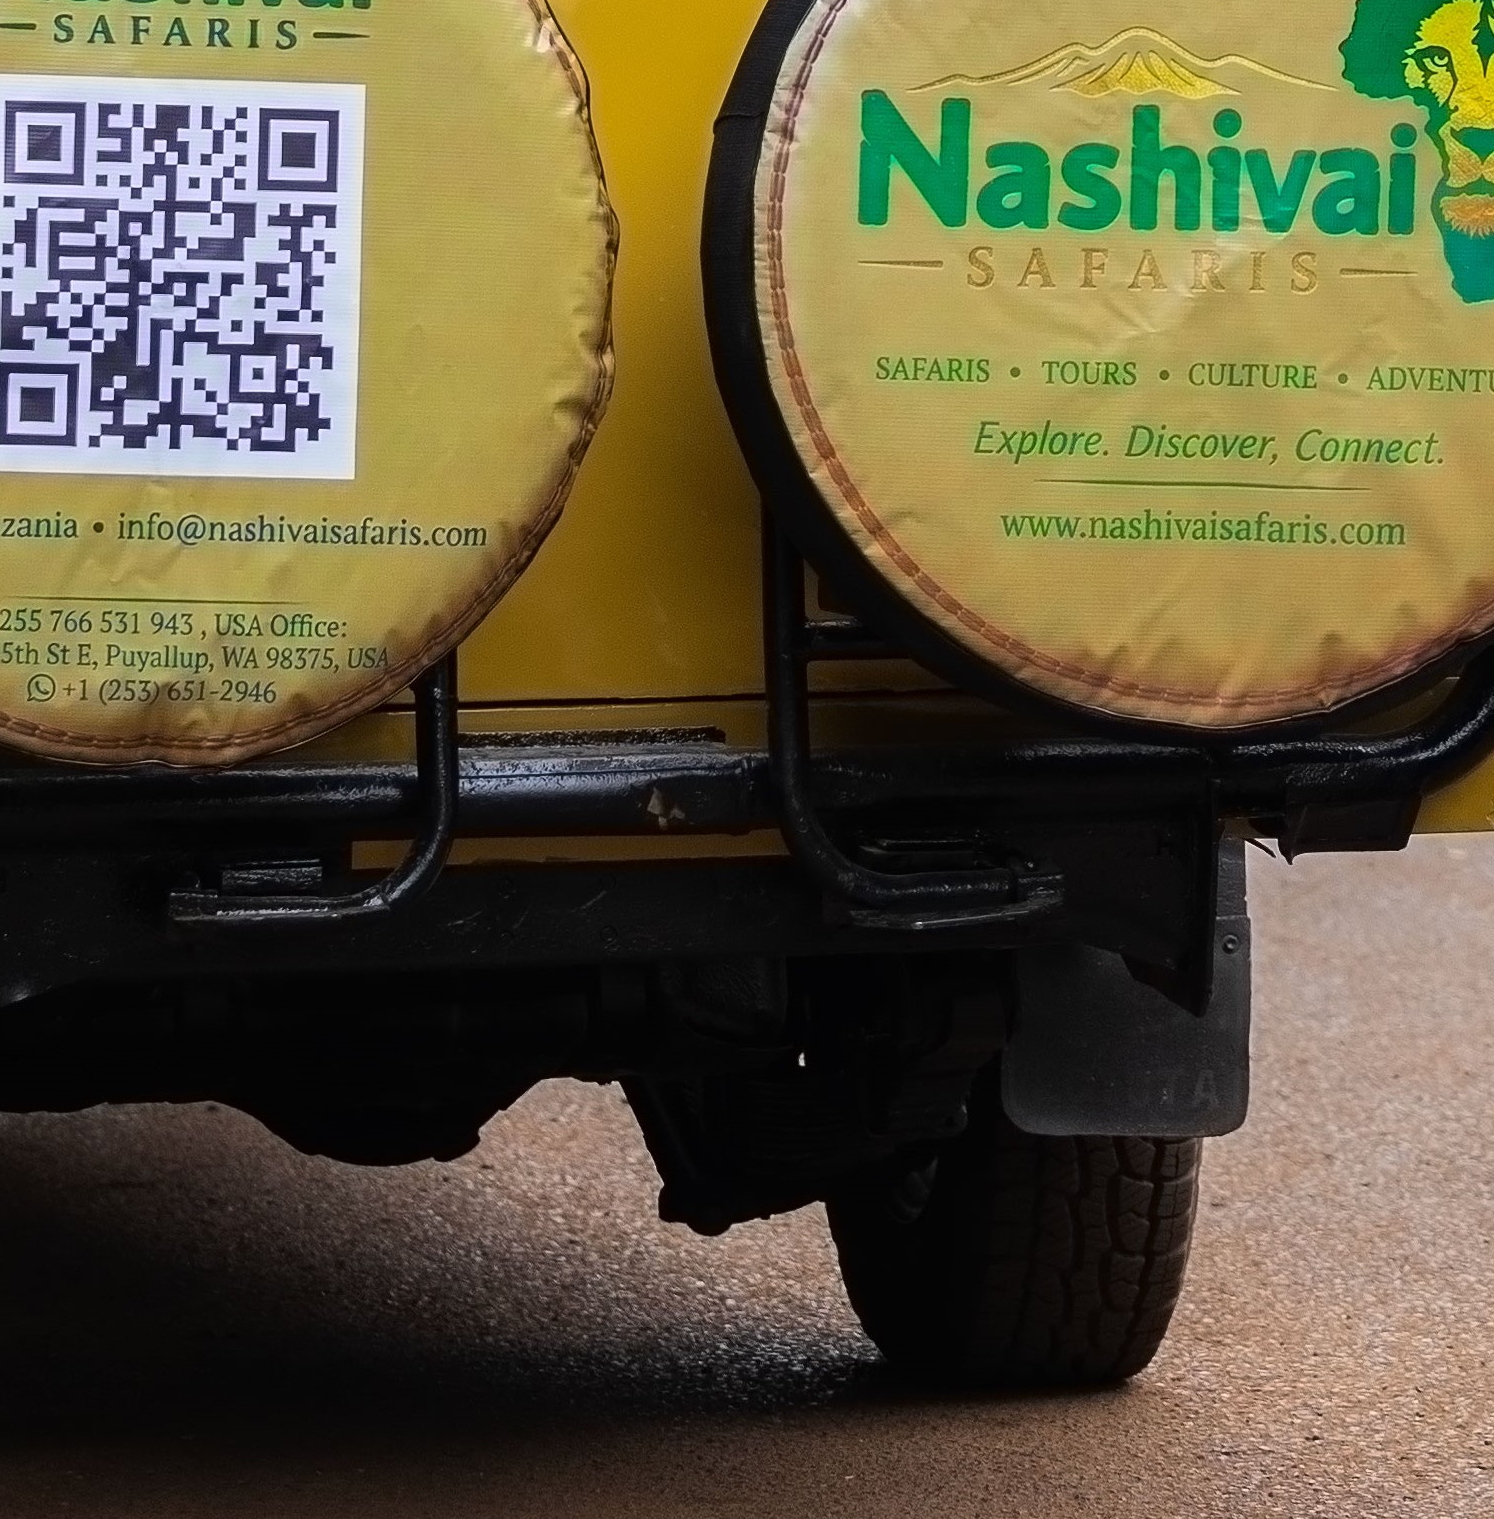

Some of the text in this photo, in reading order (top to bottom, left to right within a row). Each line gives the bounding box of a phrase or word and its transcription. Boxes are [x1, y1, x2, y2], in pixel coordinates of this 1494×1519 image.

[51, 12, 301, 49] SAFARIS
[856, 89, 1416, 236] Nashivai
[967, 246, 1320, 293] SAFARIS
[874, 357, 990, 383] SAFARIS
[1042, 361, 1137, 386] TOURS
[1188, 363, 1318, 389] CULTURE
[973, 421, 1445, 465] Explore. Discover, Connect.
[116, 512, 487, 548] info@nashivaisafaris.com
[1001, 511, 1406, 546] www.nashivaisafaris.com
[48, 609, 92, 634] 766
[99, 610, 142, 635] 531
[215, 614, 264, 637] USA
[270, 613, 348, 639] Office:
[46, 641, 72, 665] St
[77, 643, 100, 670] E,
[106, 643, 216, 675] Puyallup,
[221, 646, 260, 669] WA
[265, 647, 342, 673] 98375,
[348, 647, 390, 670] USA
[62, 677, 278, 706] +1 (253) 651-2946
